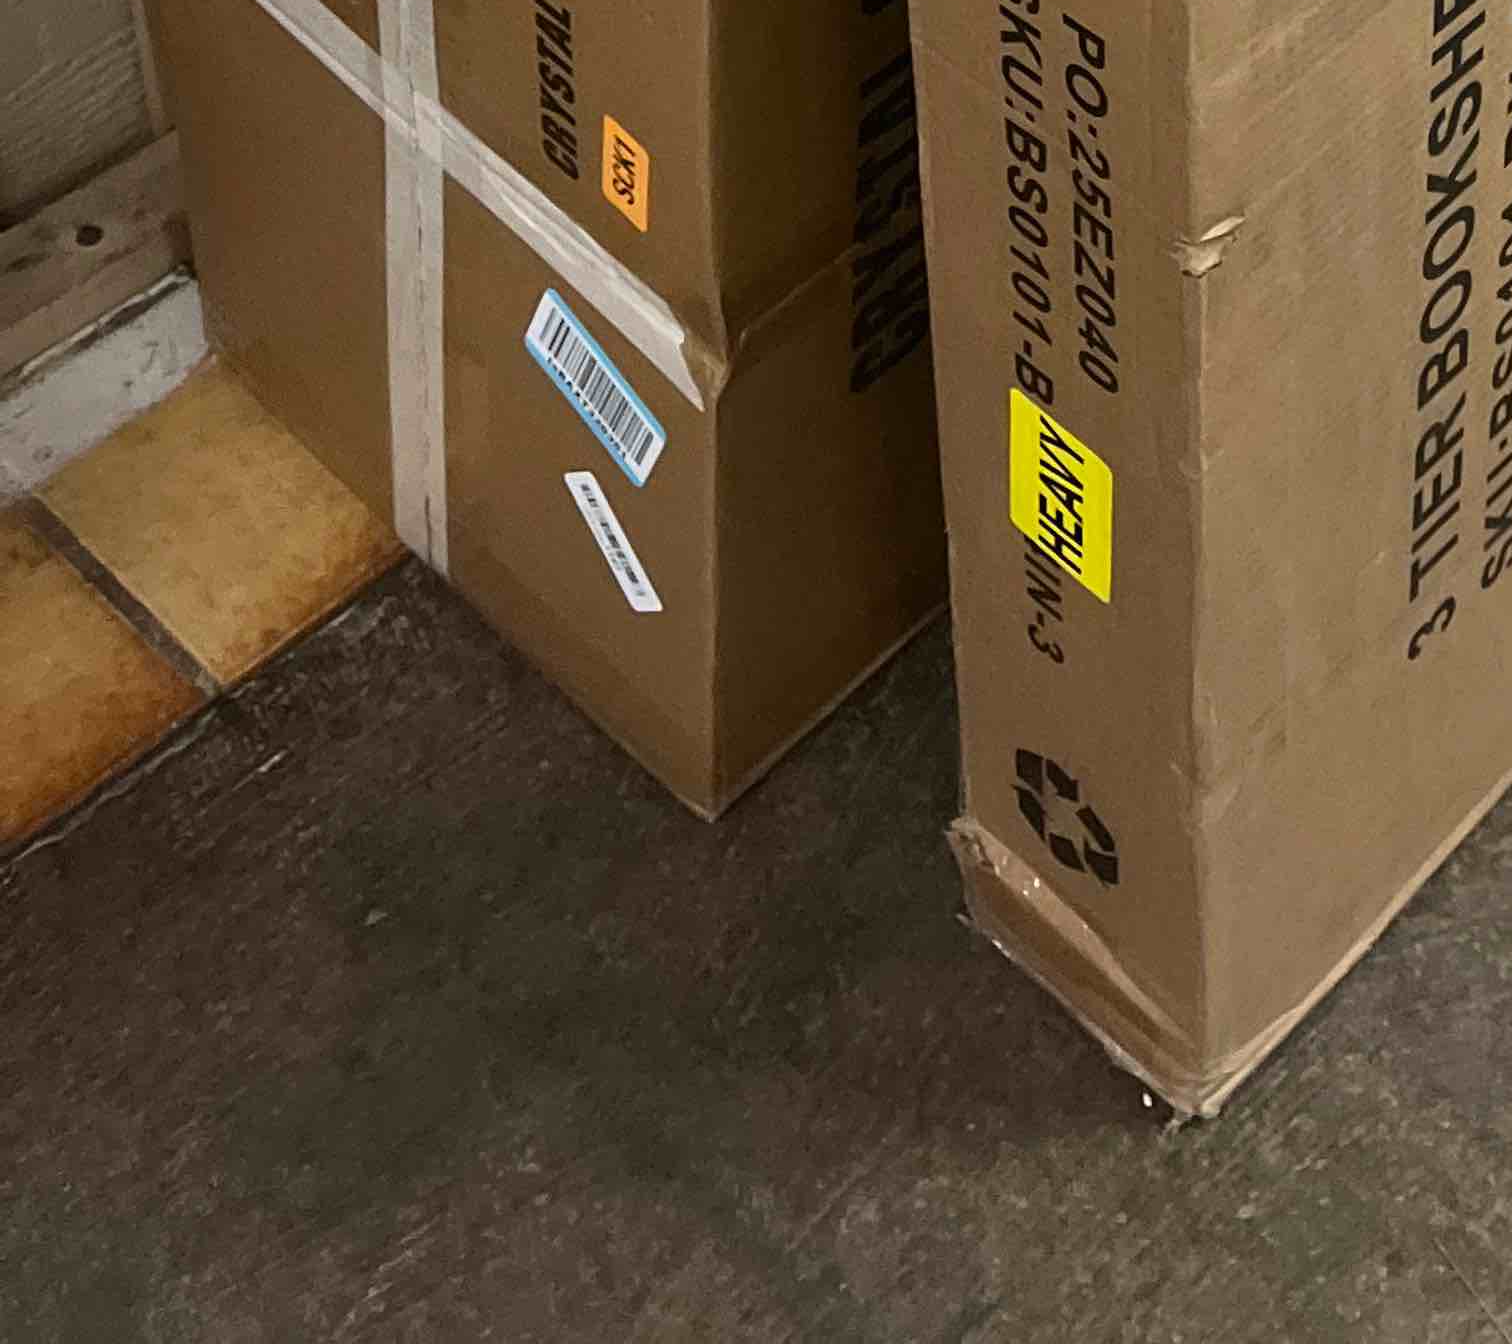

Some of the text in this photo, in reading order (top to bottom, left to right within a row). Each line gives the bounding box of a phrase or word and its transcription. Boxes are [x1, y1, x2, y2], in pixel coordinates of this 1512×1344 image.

[611, 136, 639, 205] SCK1
[1062, 14, 1118, 393] PO:25EZ040
[1038, 415, 1084, 574] HEAVY
[1410, 392, 1466, 602] TIER
[1408, 597, 1456, 660] 3
